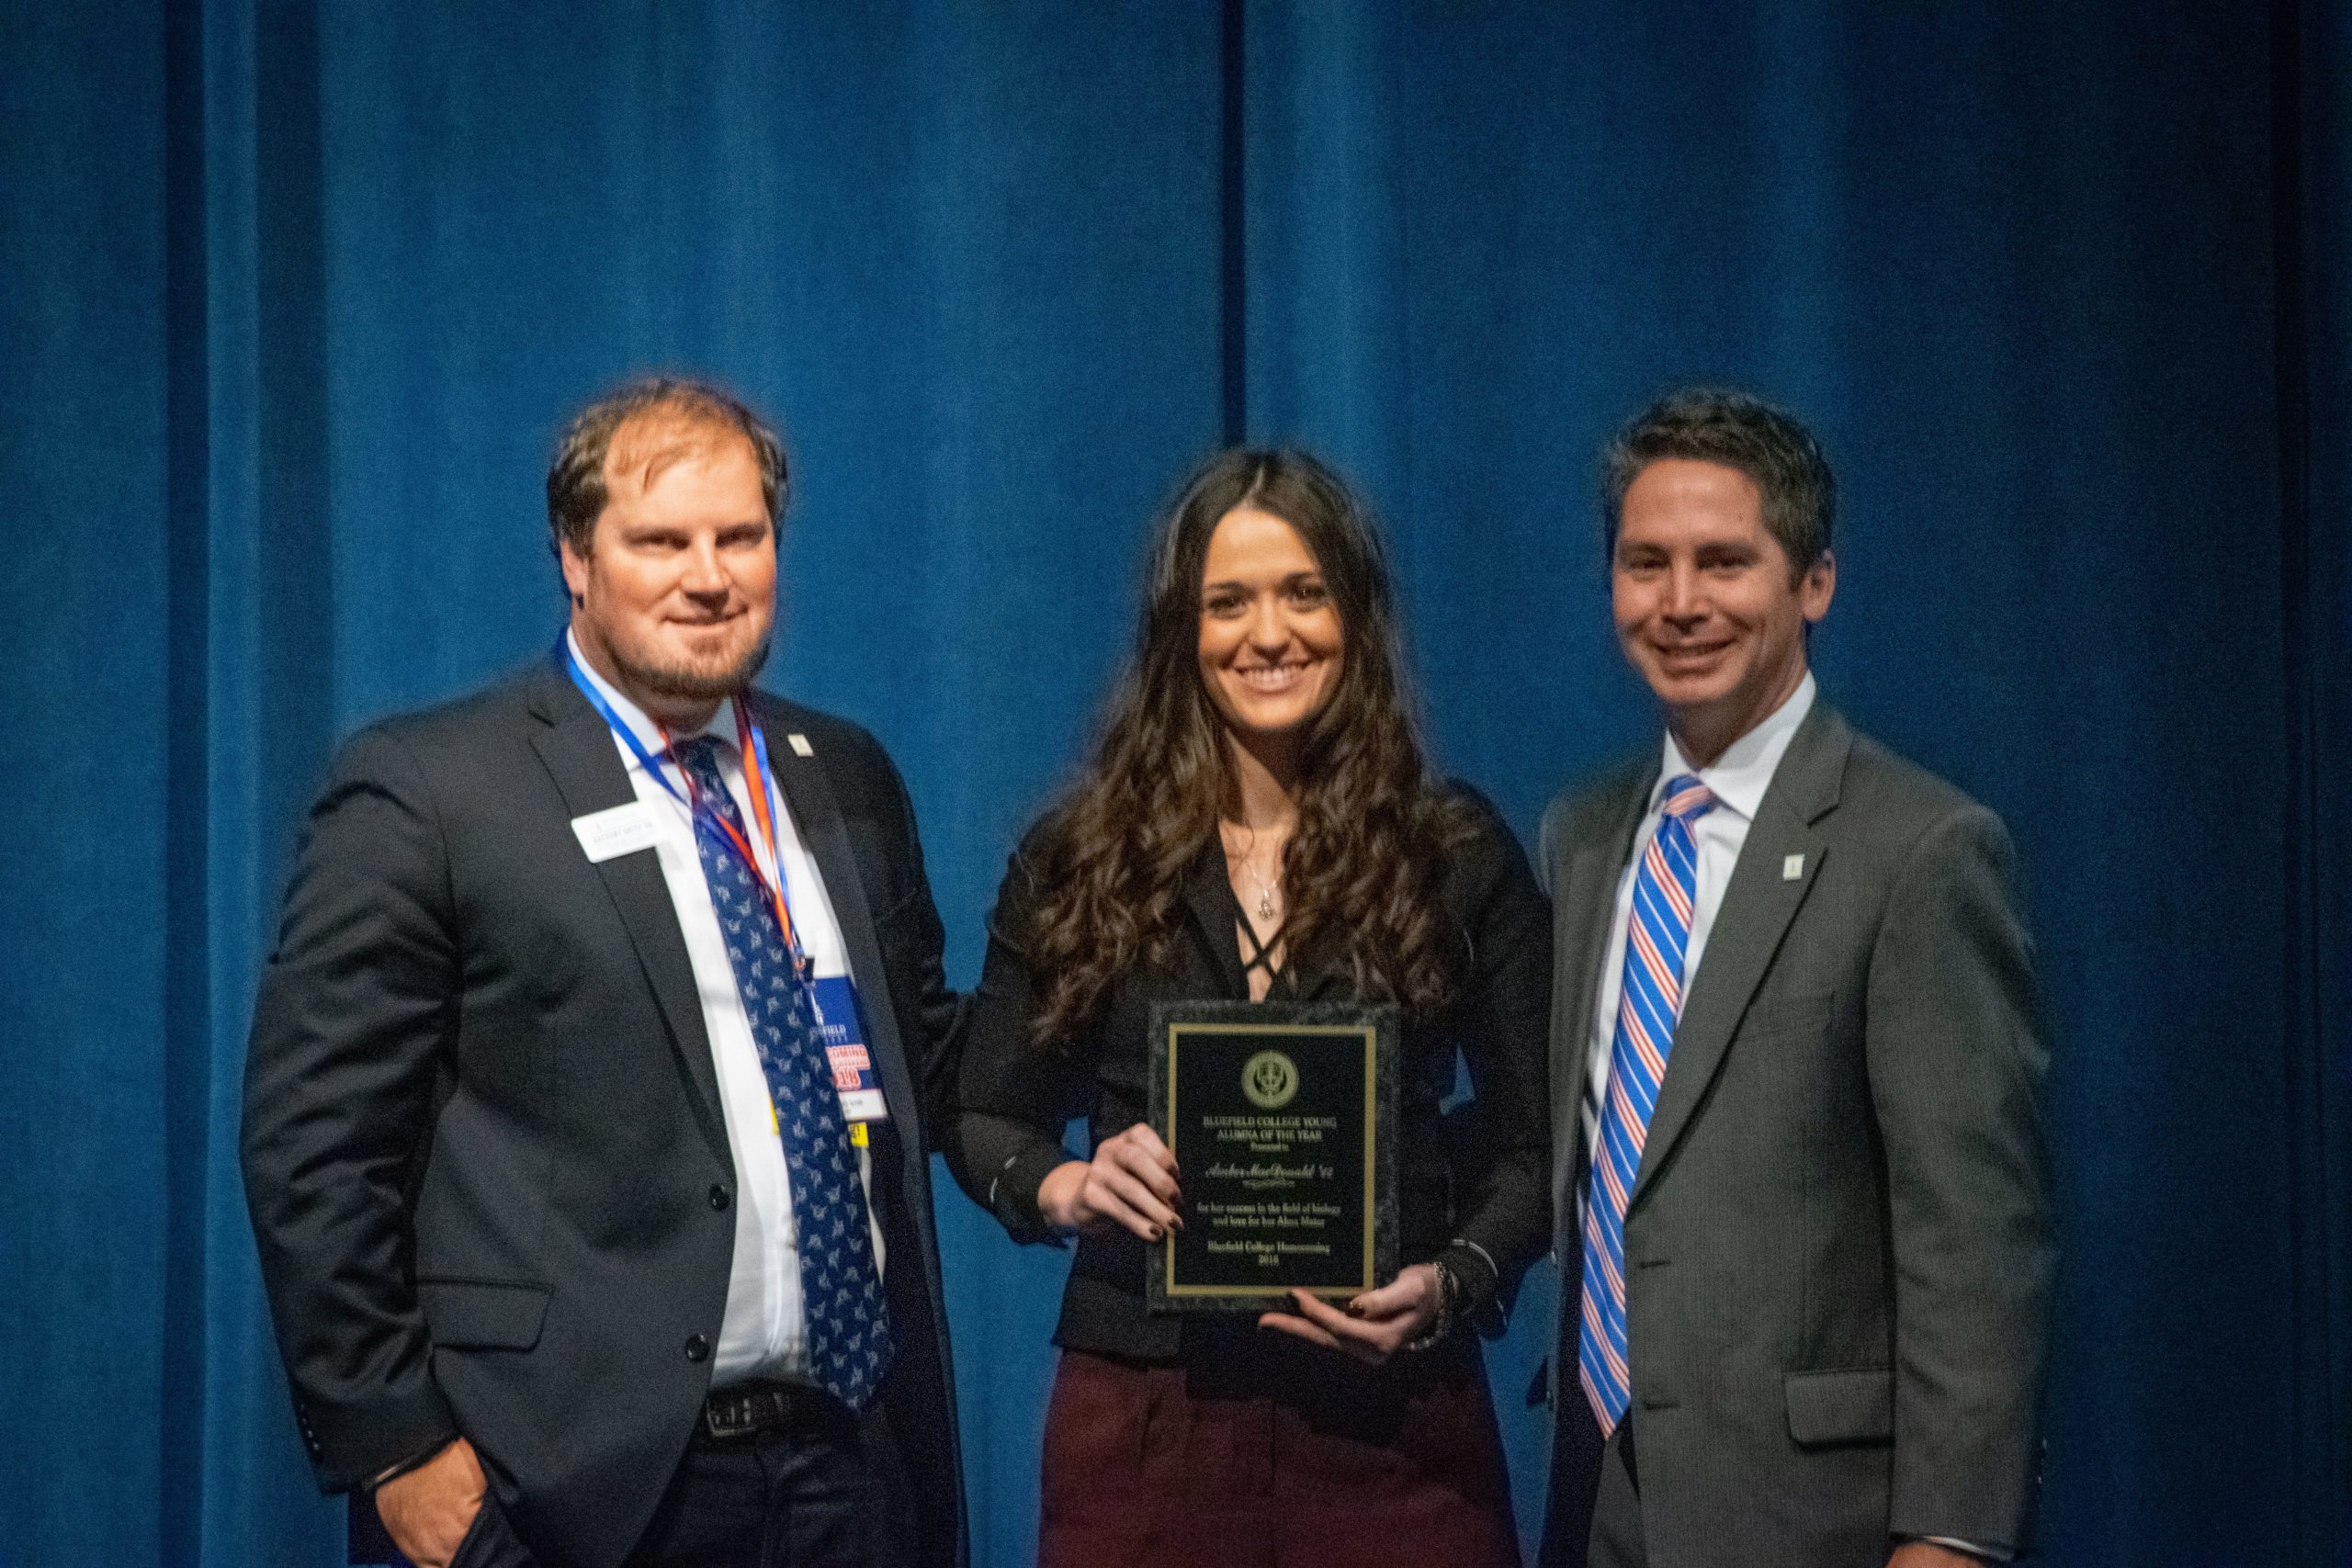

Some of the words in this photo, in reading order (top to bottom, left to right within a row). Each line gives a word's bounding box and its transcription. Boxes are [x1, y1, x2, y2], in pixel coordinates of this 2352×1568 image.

[1203, 1116, 1255, 1128] BLUEFIELD
[1257, 1116, 1301, 1128] COLLEGE
[1303, 1116, 1337, 1128] YOUNG
[1217, 1129, 1259, 1141] ALUMNA
[1260, 1129, 1274, 1141] OF
[1275, 1129, 1295, 1141] THE
[1297, 1129, 1322, 1141] YEAR
[1197, 1202, 1209, 1213] for
[1211, 1202, 1225, 1213] her
[1226, 1204, 1256, 1213] success
[1257, 1202, 1266, 1213] in
[1267, 1202, 1281, 1213] the
[1283, 1202, 1301, 1213] field
[1302, 1202, 1312, 1213] of
[1312, 1202, 1341, 1216] biology
[1213, 1215, 1228, 1226] and
[1229, 1215, 1247, 1226] love
[1248, 1215, 1260, 1226] for
[1261, 1215, 1275, 1226] her
[1276, 1215, 1299, 1226] Alma
[1300, 1215, 1325, 1226] Mater
[1207, 1241, 1243, 1253] Bluefield
[1245, 1241, 1275, 1254] College
[1276, 1241, 1330, 1256] Homecoming
